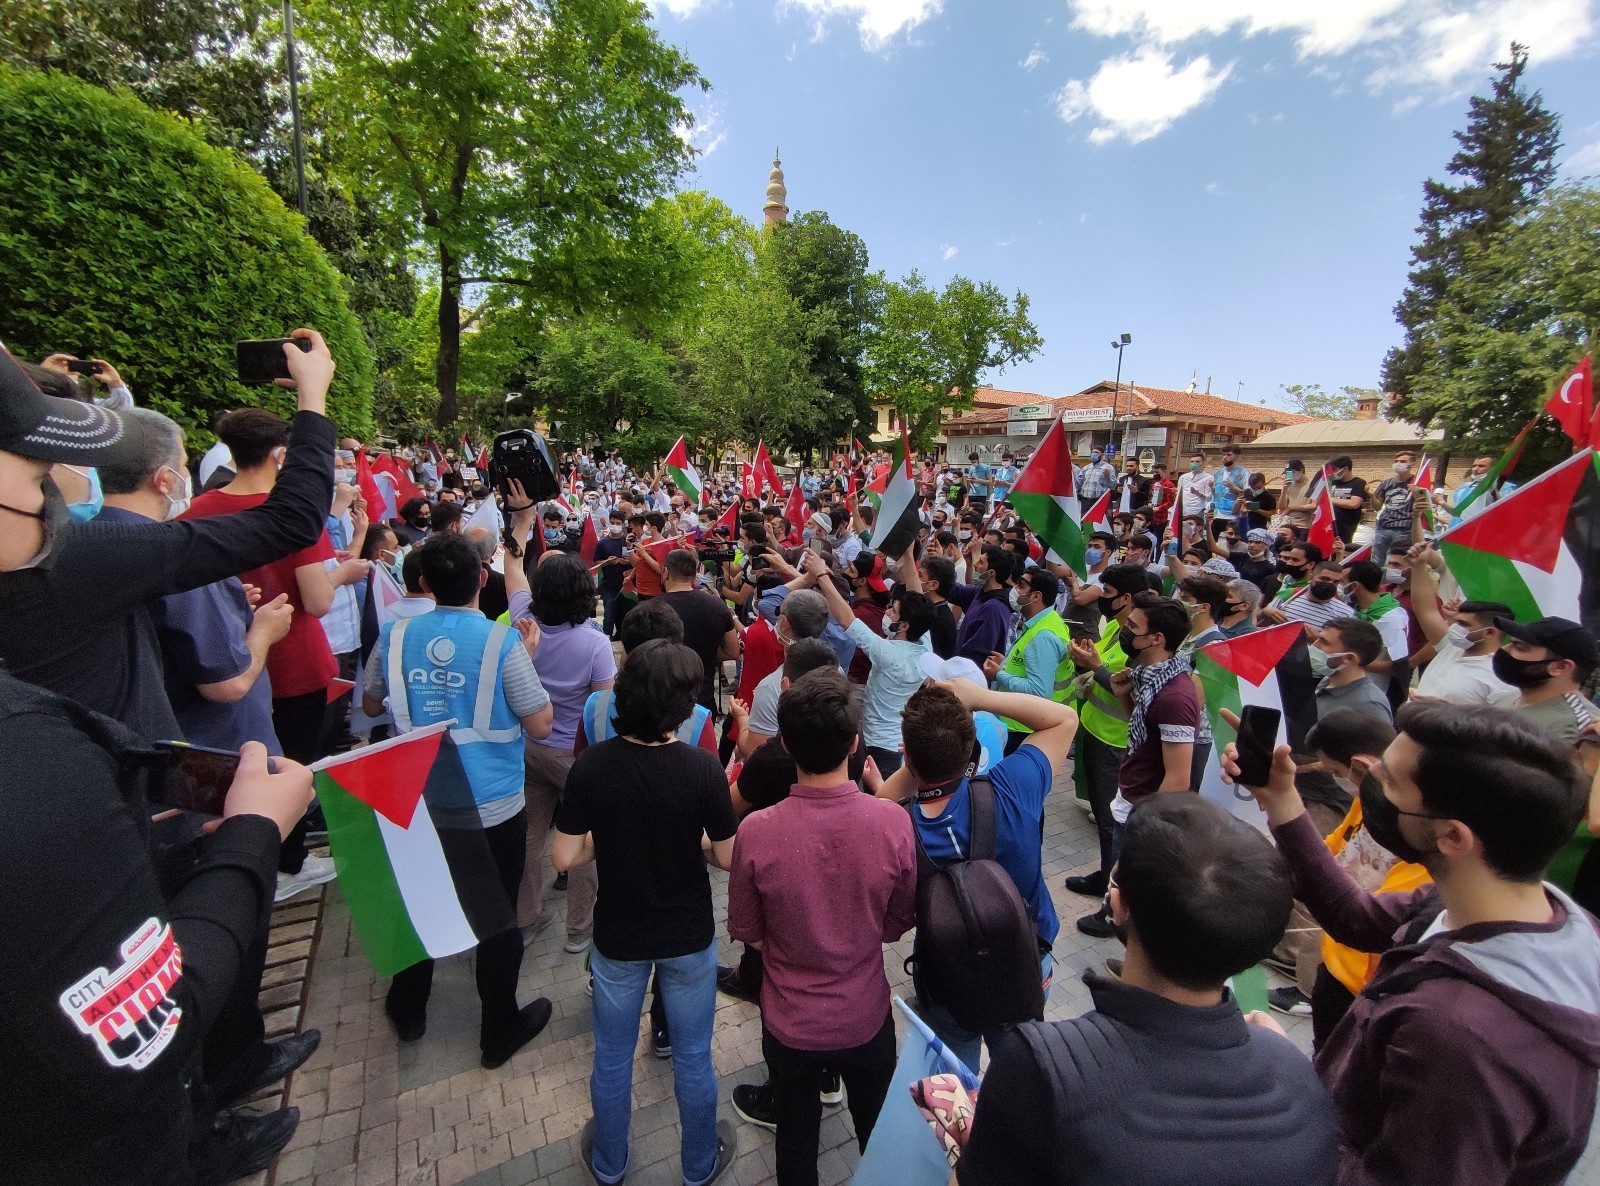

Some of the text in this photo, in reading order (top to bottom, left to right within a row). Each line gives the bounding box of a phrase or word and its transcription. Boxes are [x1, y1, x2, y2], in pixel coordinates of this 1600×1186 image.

[408, 668, 466, 688] AGD
[964, 761, 976, 778] EOS
[68, 974, 107, 1010] CITY
